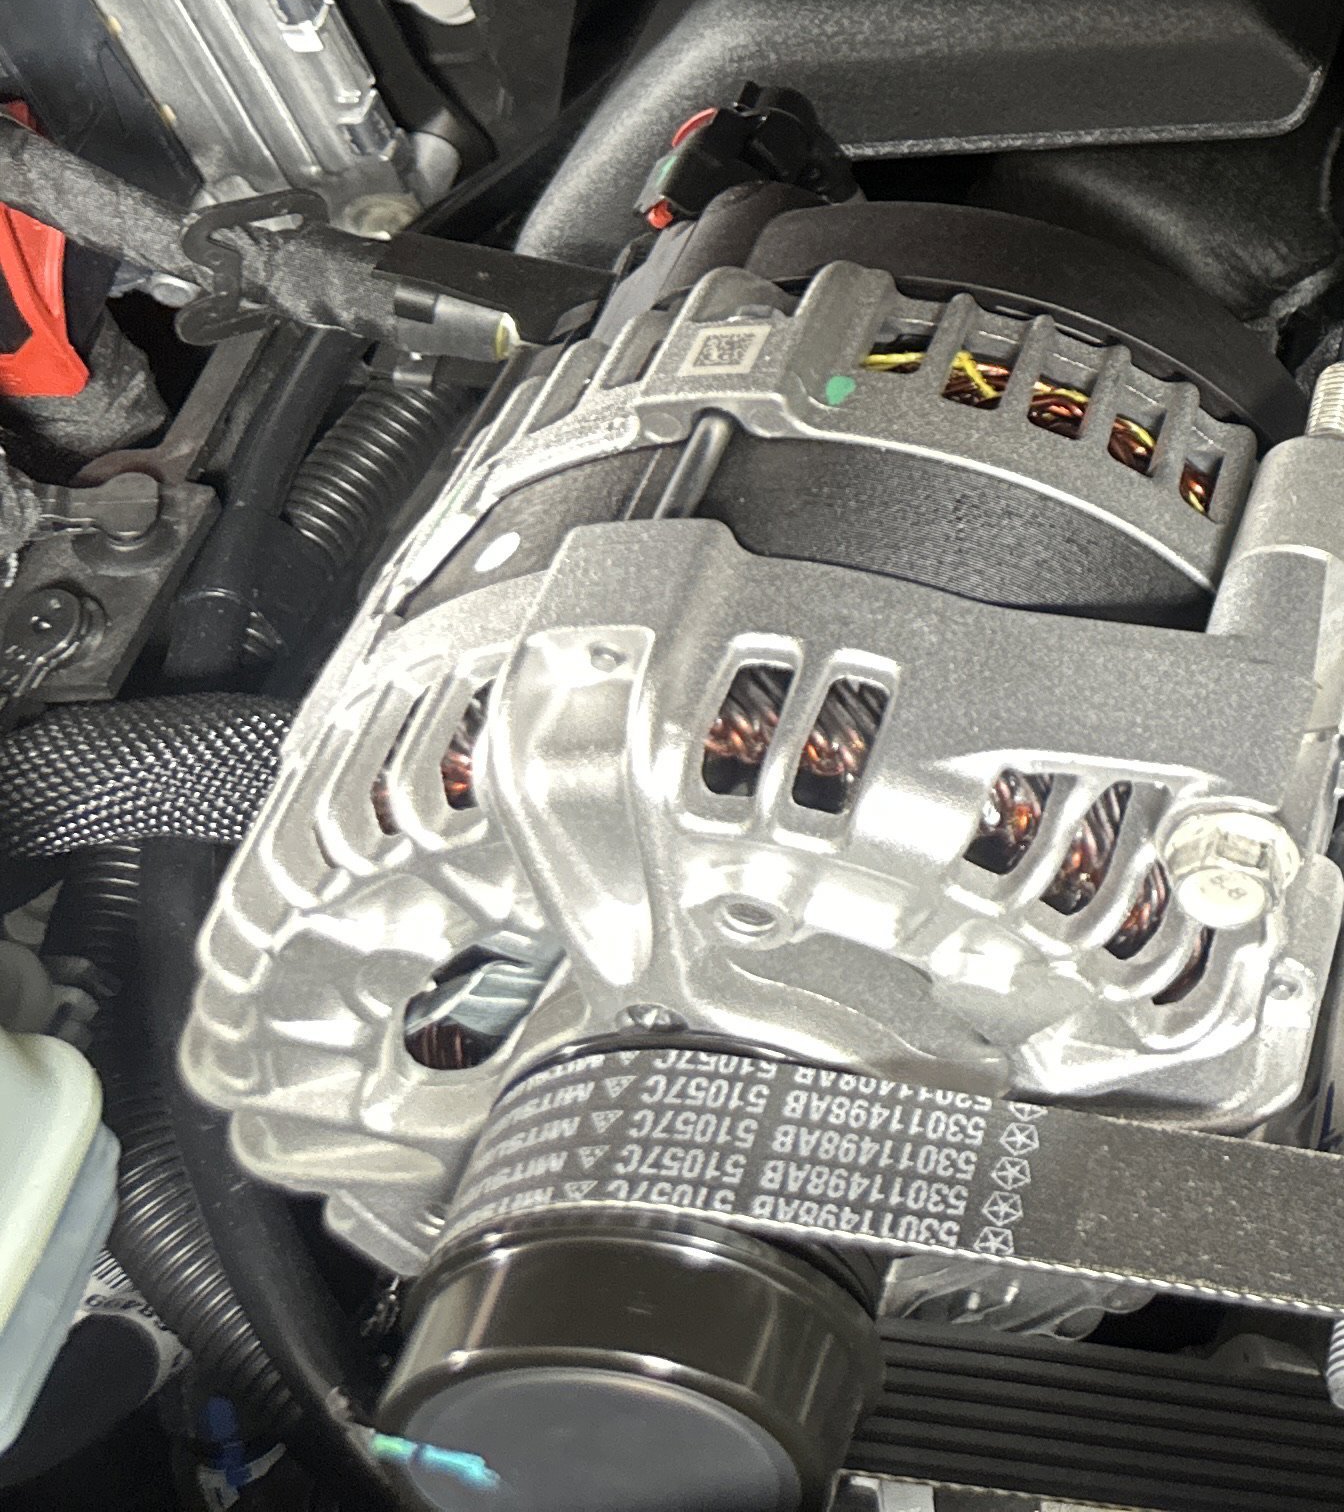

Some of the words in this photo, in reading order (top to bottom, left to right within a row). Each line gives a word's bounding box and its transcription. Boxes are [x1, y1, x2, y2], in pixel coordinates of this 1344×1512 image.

[641, 1073, 770, 1114] 51057C
[782, 1089, 987, 1146] 53011498AB
[628, 1108, 759, 1148] 51057C
[771, 1124, 978, 1181] 53011498AB
[615, 1143, 747, 1185] 51057C
[759, 1159, 969, 1216] 53011498AB
